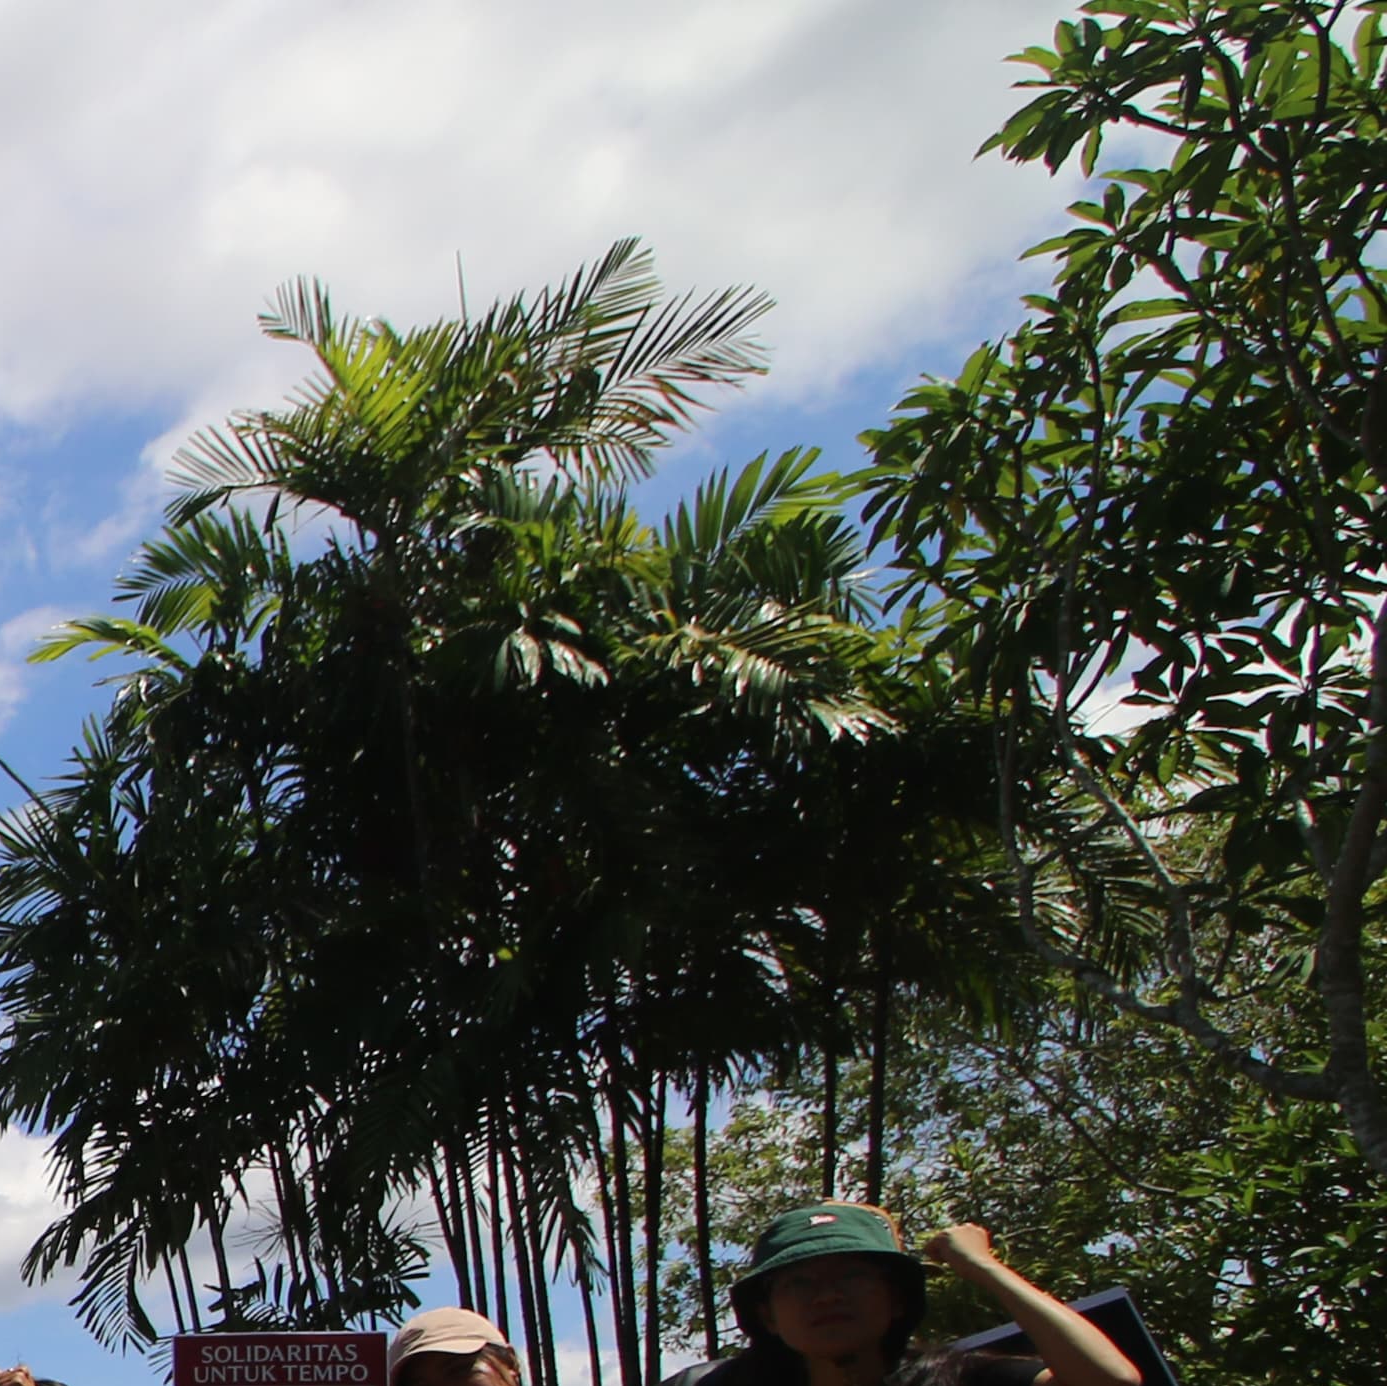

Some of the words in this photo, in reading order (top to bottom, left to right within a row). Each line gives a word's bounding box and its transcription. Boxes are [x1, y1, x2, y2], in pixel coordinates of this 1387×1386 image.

[201, 1344, 358, 1364] SOLIDARITAS
[194, 1365, 276, 1383] UNTUK
[283, 1364, 369, 1382] TEMPO
